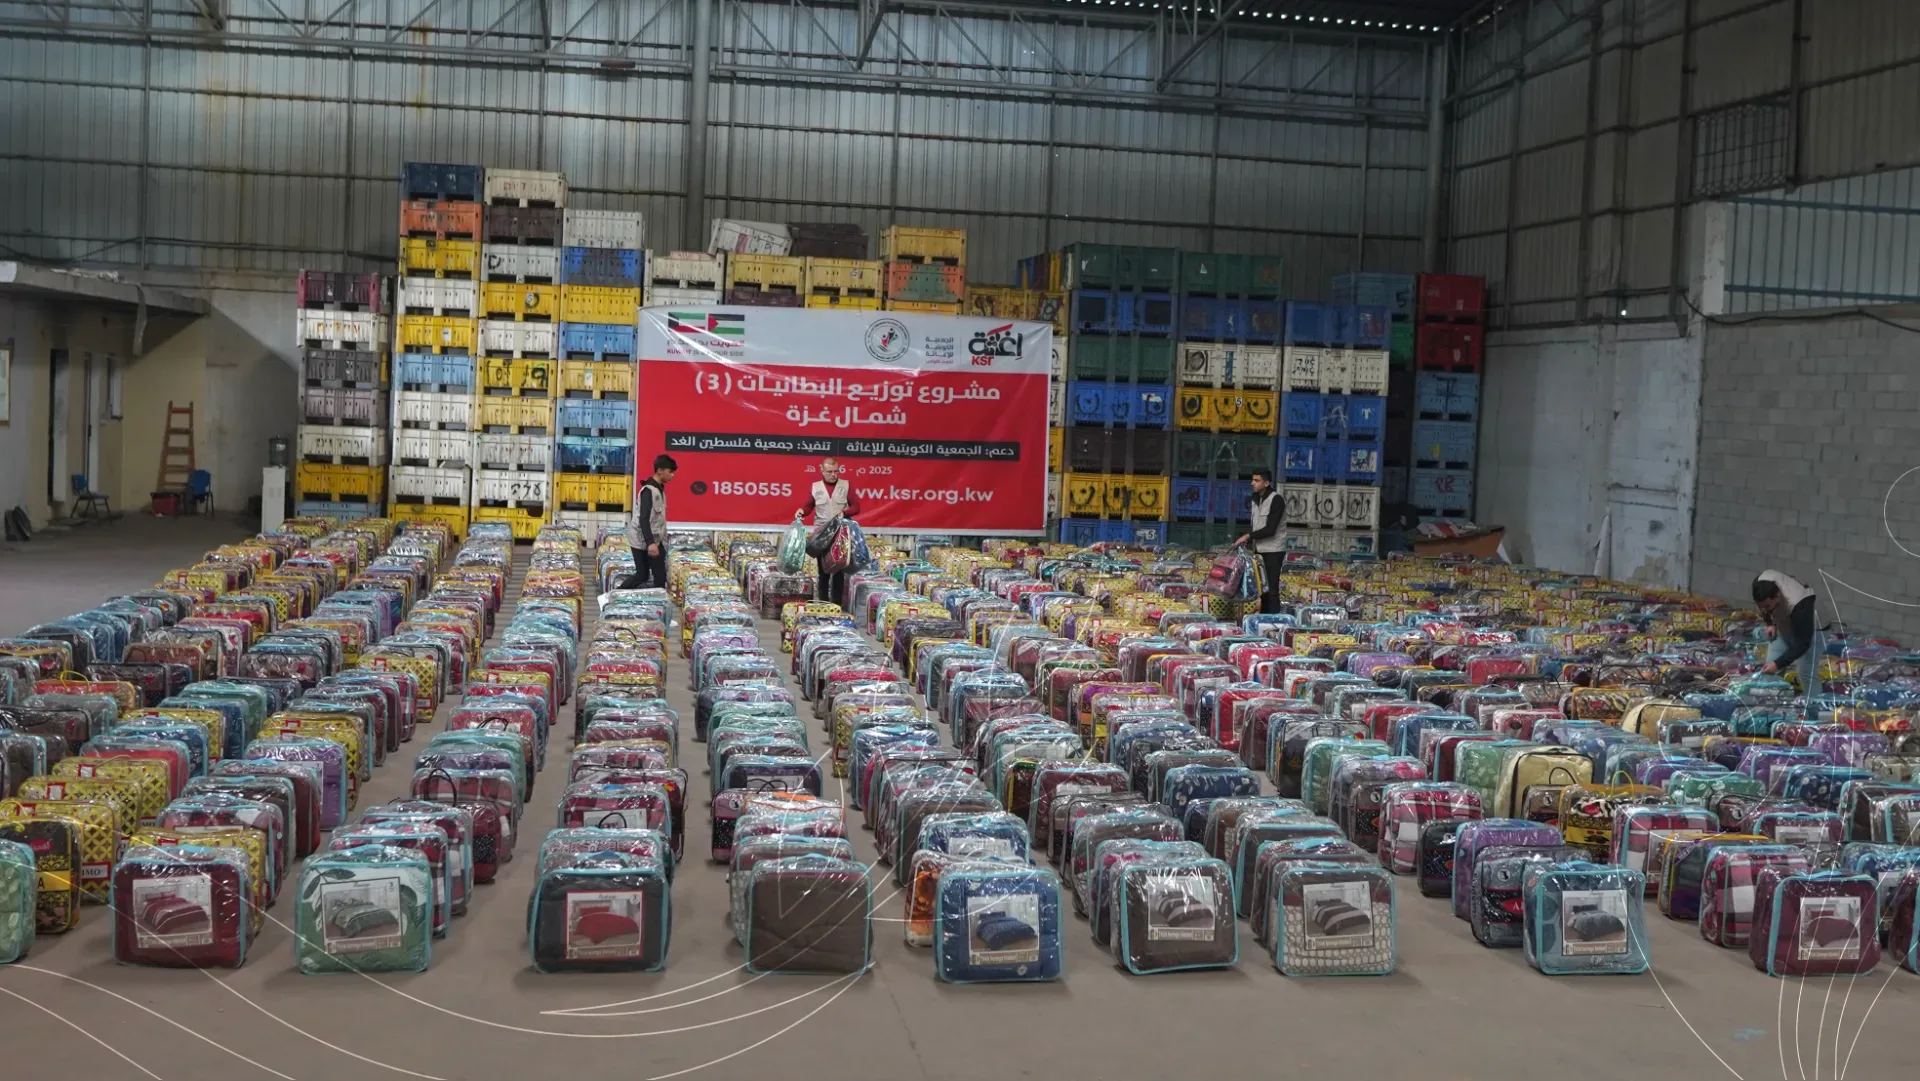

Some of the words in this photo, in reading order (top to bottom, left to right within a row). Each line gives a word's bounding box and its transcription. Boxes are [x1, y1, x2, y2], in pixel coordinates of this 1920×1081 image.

[695, 371, 732, 395] (3)
[737, 374, 842, 399] البطانيات
[847, 380, 914, 402] توزيع
[917, 380, 1000, 404] مشروع
[785, 405, 831, 427] غزة
[835, 405, 906, 428] شمال
[670, 436, 696, 447] الغد
[699, 437, 750, 449] فلسطين
[754, 438, 793, 450] جمعية
[797, 441, 831, 452] تنفيذ:
[846, 441, 884, 455] للإغاثة
[887, 443, 933, 456] الكويتية
[936, 444, 982, 457] الجمعية
[985, 447, 1015, 458] دعم:
[868, 465, 893, 475] 2025
[712, 481, 792, 497] 1850555
